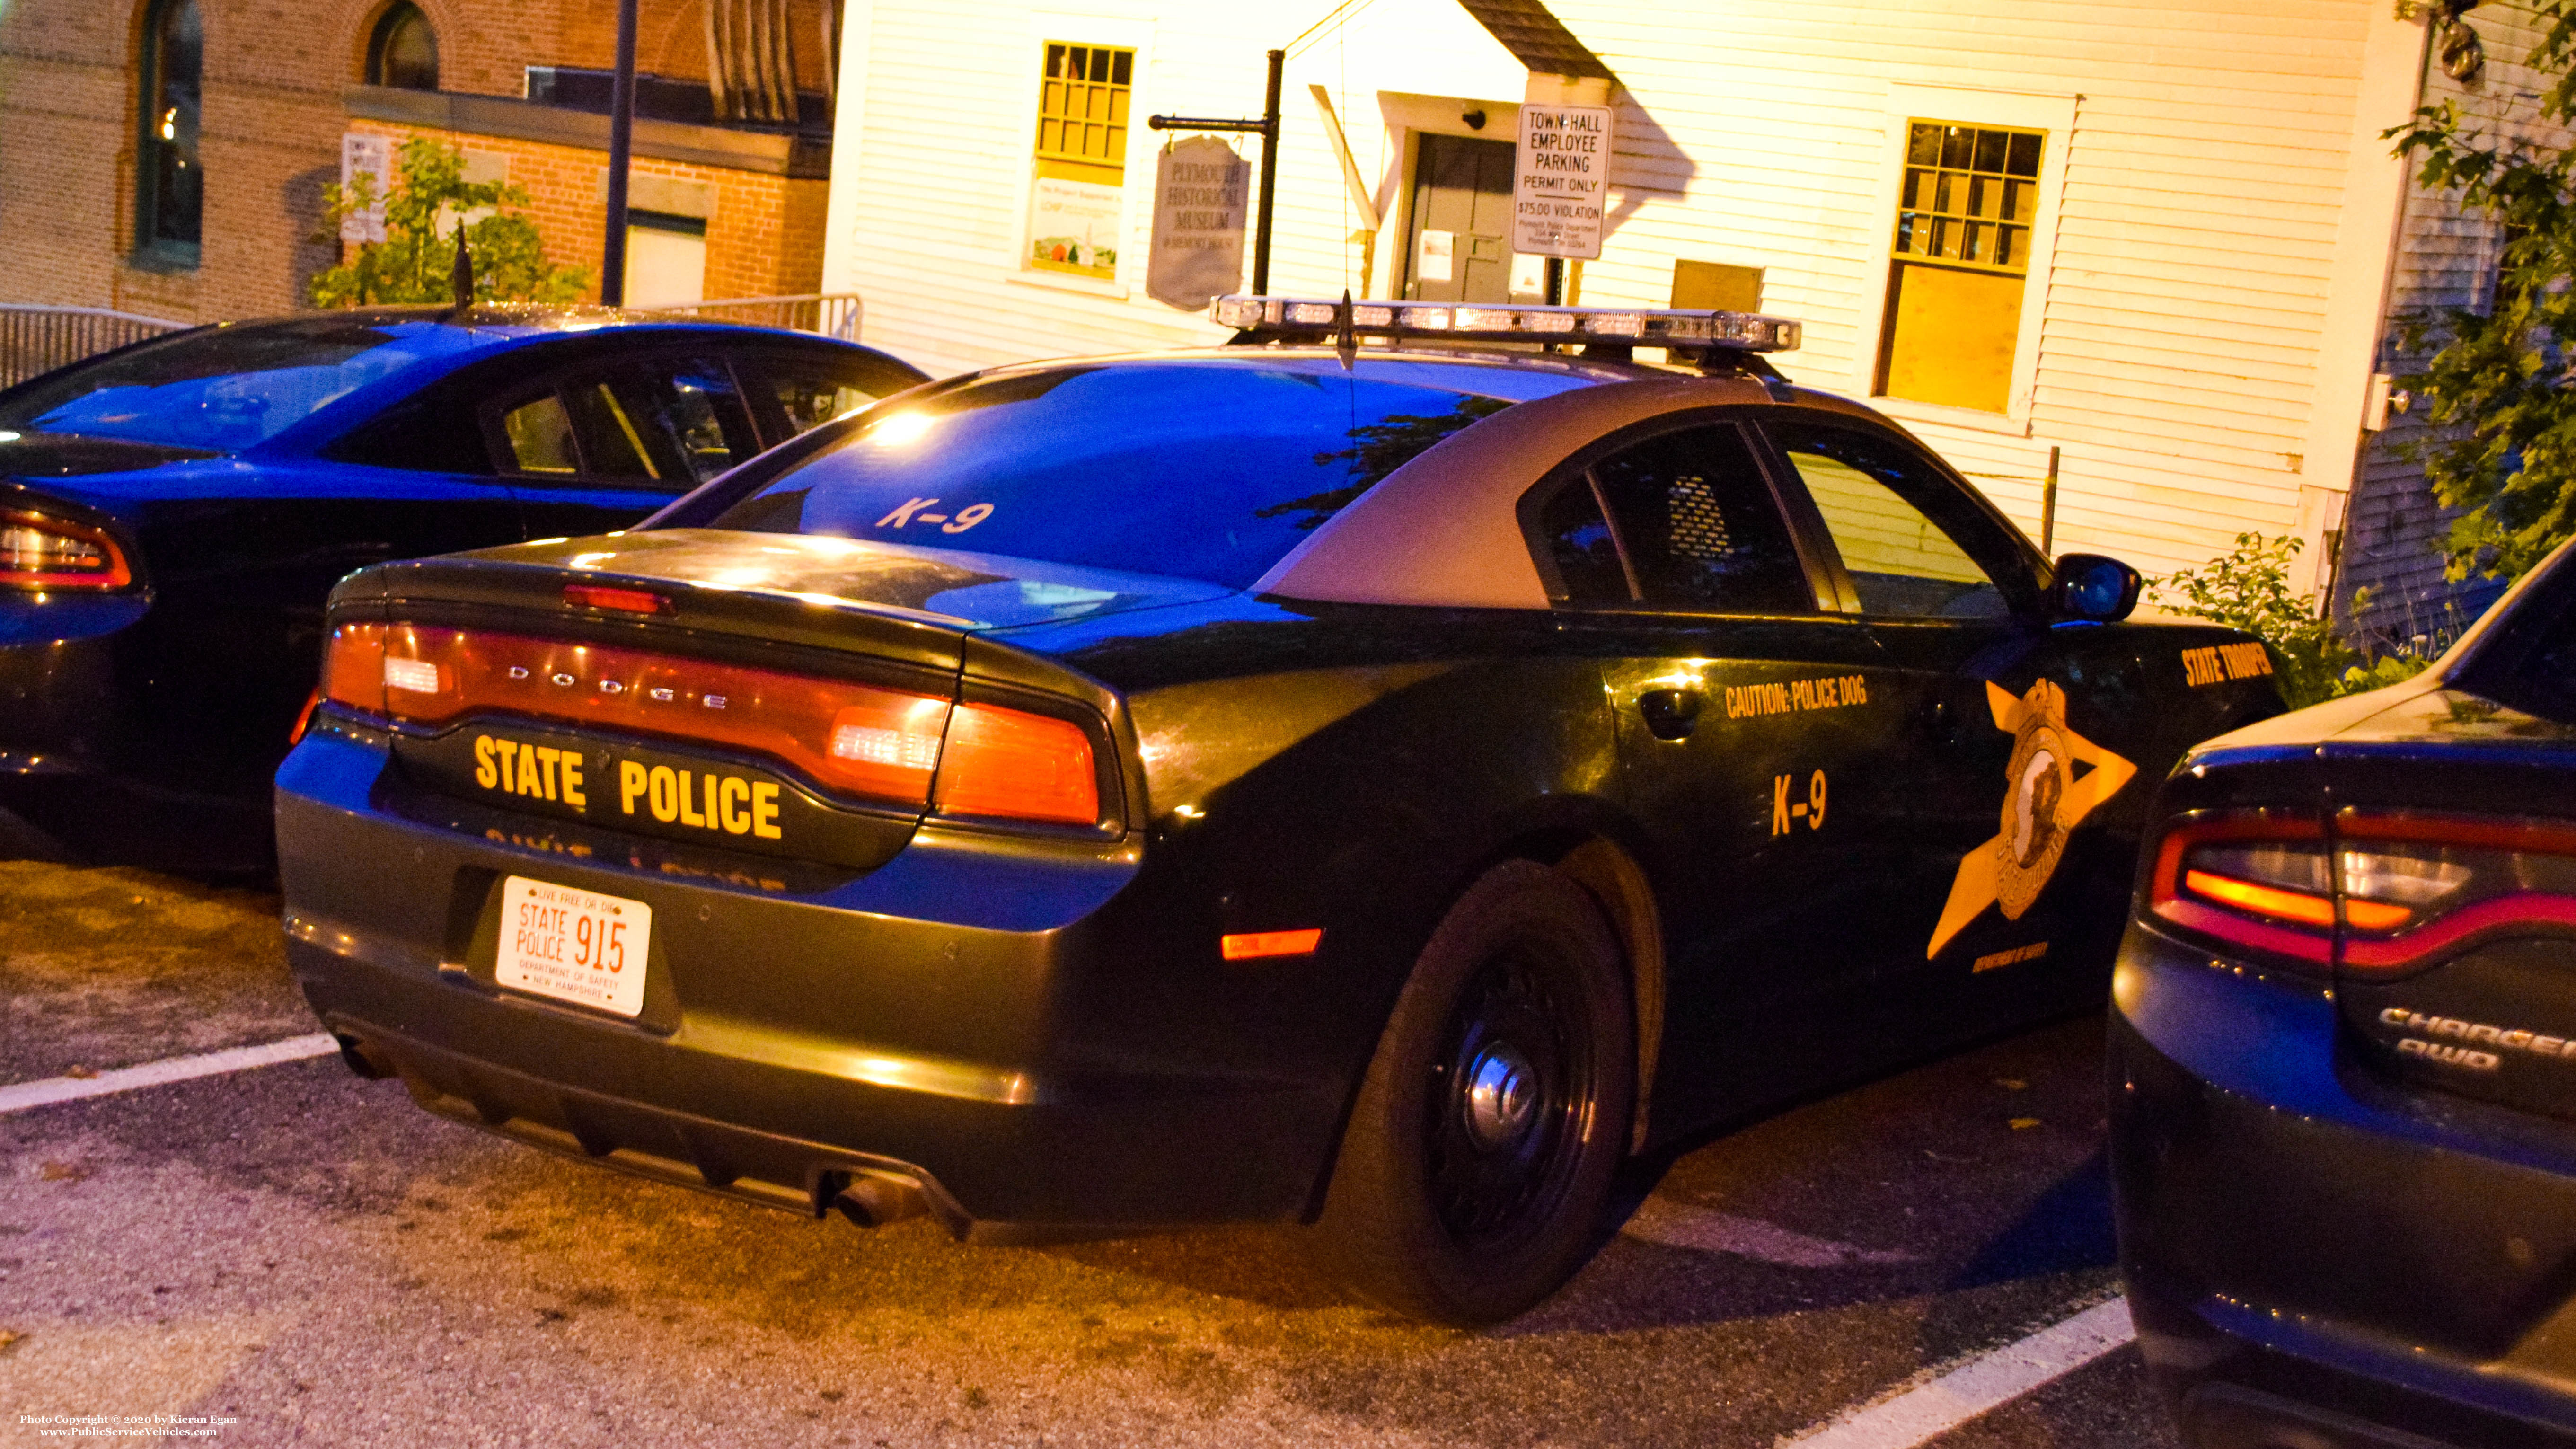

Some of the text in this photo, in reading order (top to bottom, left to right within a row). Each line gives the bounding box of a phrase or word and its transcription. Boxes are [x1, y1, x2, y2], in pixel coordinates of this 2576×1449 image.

[1530, 112, 1602, 133] TOWN HALL
[1531, 133, 1597, 152] EMPLOYEE
[1535, 153, 1590, 173] PARKING
[1524, 176, 1598, 192] PERMIT ONLY
[1518, 202, 1600, 219] $75.00 VIOLATION
[875, 497, 994, 533] K-9
[2182, 642, 2273, 686] STATE TROOPER
[508, 666, 727, 709] DODGE
[1726, 674, 1867, 718] CAUTION: POLICE DOG
[475, 734, 782, 839] STATE POLICE
[1773, 769, 1826, 836] K-9
[538, 889, 615, 912] LIVE FREE OR DIE
[516, 929, 565, 962] POLICE
[520, 902, 626, 973] STATE 915
[520, 959, 619, 990] DEPARTMENT OF SAFETY
[533, 976, 602, 997] NEW HAMPSHIRE
[2397, 1038, 2498, 1070] AWD
